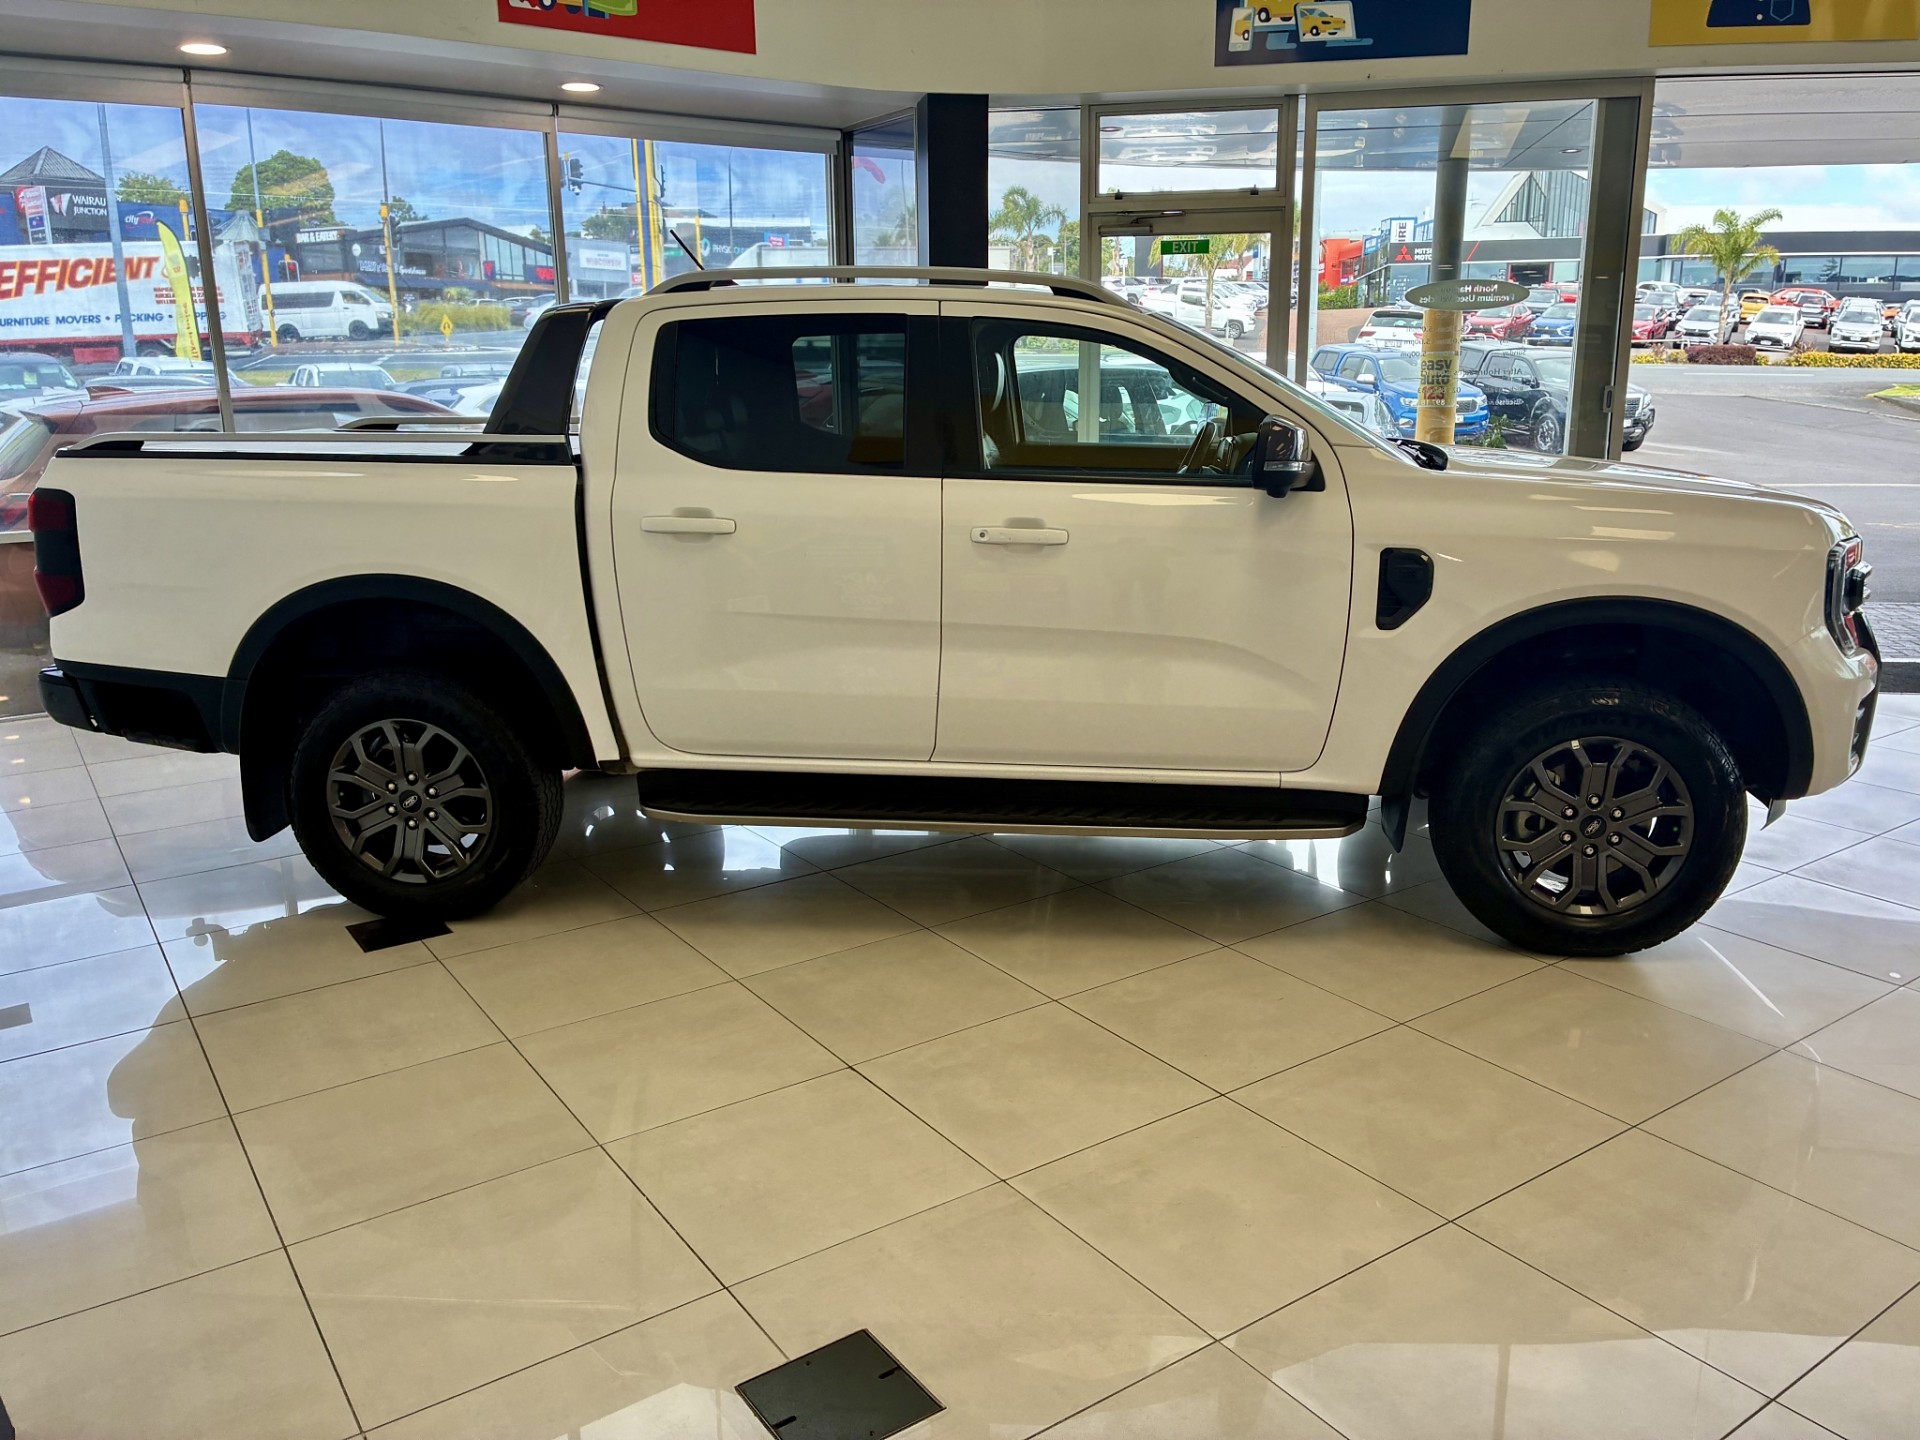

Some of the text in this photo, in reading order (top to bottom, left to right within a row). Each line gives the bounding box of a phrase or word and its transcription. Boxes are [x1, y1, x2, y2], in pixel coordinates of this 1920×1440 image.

[72, 194, 107, 207] WAIRAU
[73, 206, 108, 217] JUNCTION
[1398, 222, 1407, 242] IRE
[1172, 241, 1199, 254] EXIT
[0, 256, 160, 301] EFFICIENT
[0, 312, 164, 327] URNITURE MOVERS PCKING
[1421, 360, 1452, 371] easy
[1420, 372, 1450, 385] auto
[1423, 386, 1445, 400] 123
